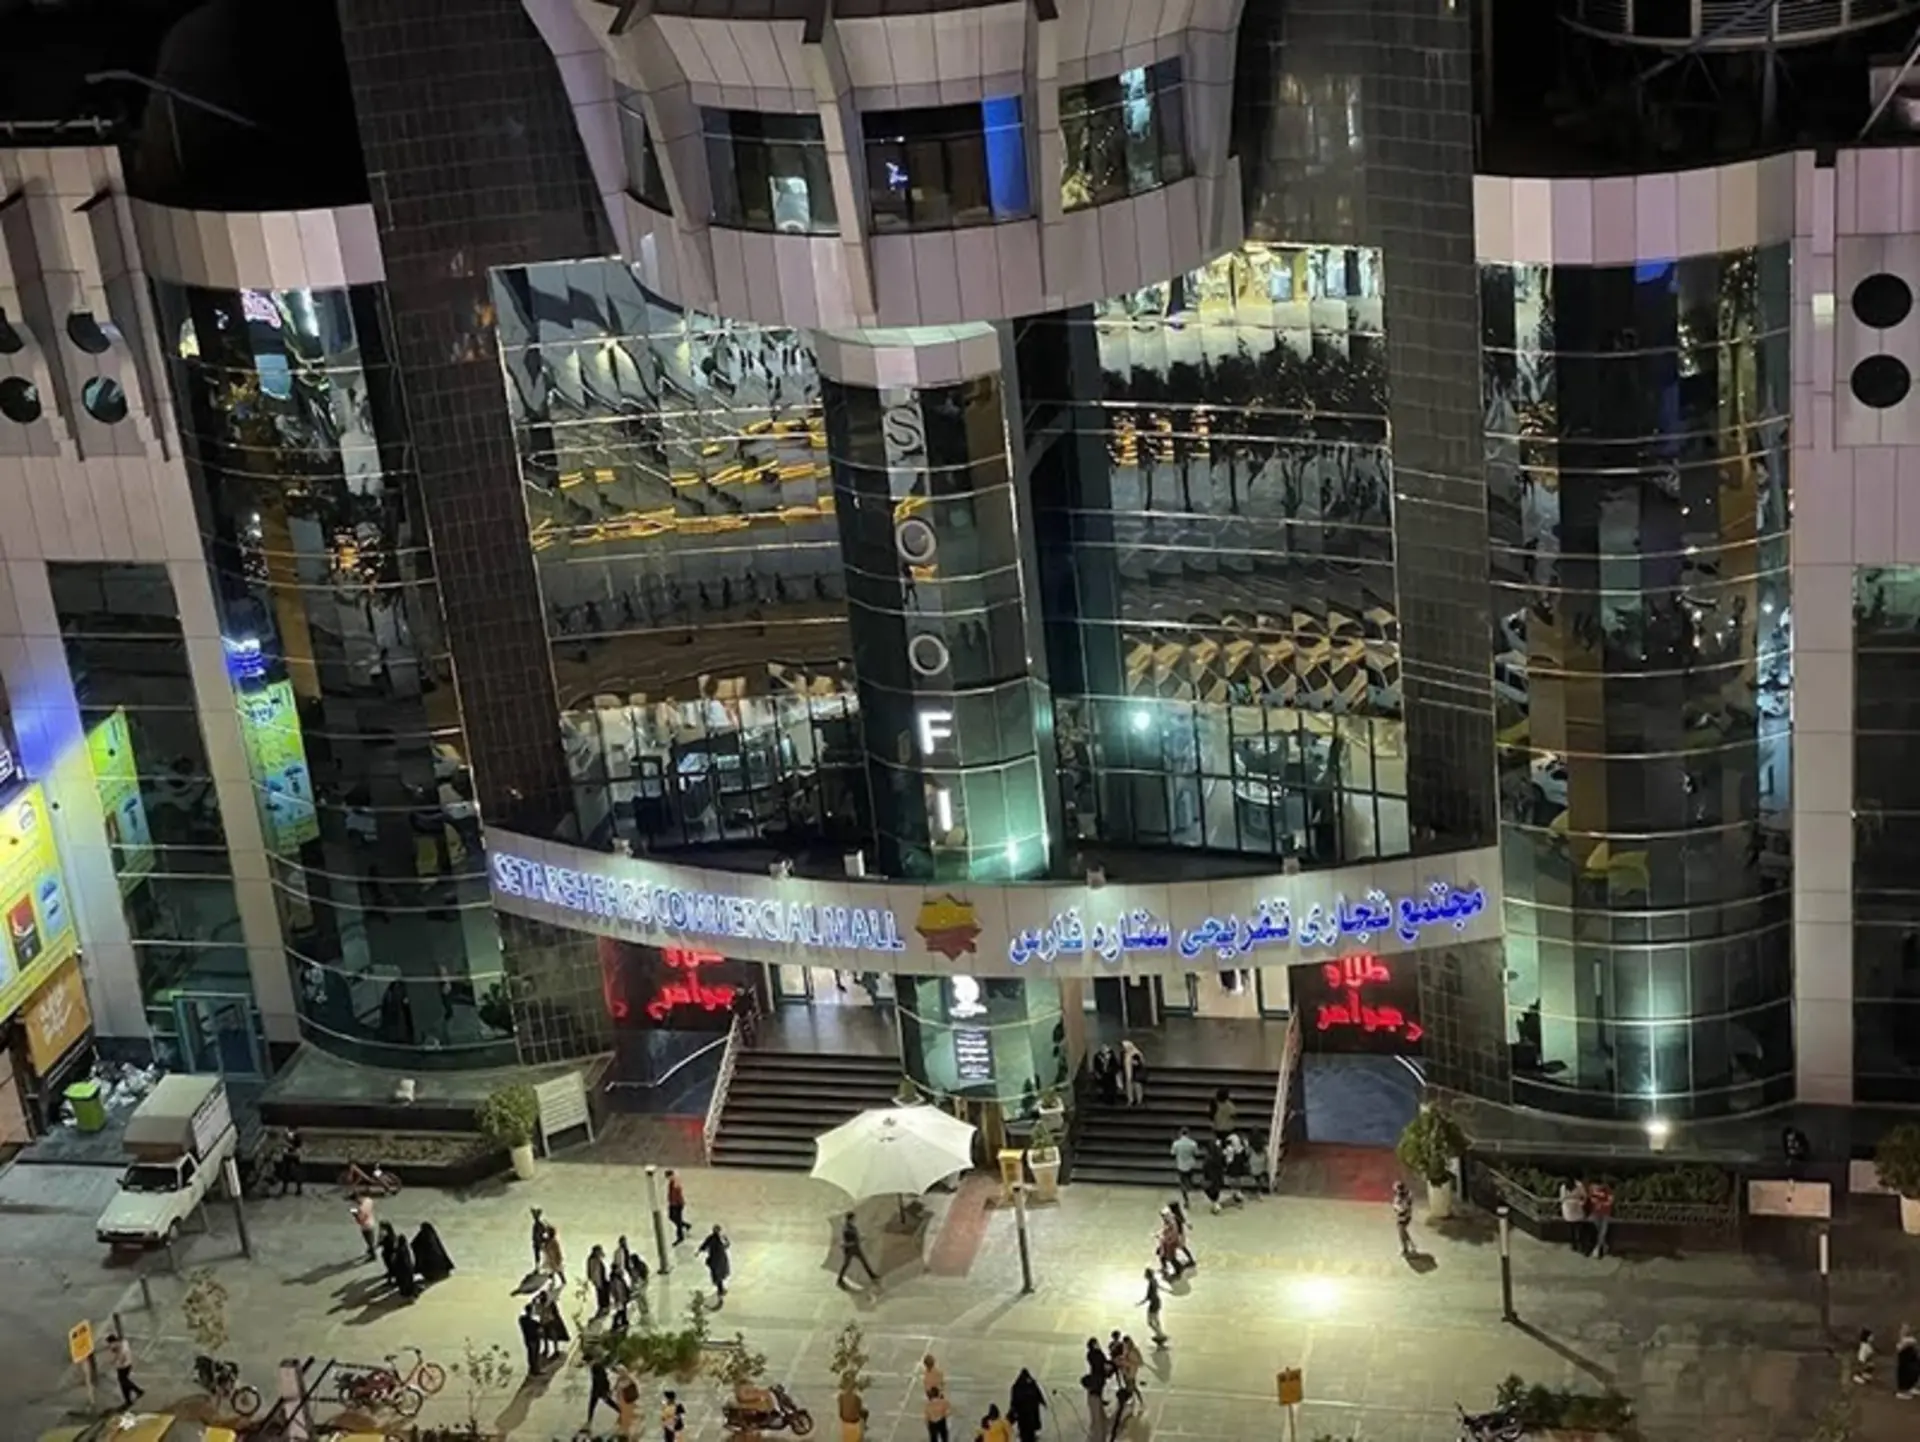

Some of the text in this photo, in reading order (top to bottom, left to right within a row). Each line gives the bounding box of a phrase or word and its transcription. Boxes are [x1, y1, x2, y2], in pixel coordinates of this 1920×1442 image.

[882, 404, 953, 832] SOOFI
[653, 885, 823, 946] COMMERCIAL
[821, 905, 906, 951] MALL
[1009, 882, 1486, 966] مجتمع تجاری تفریحی ستاره فارس
